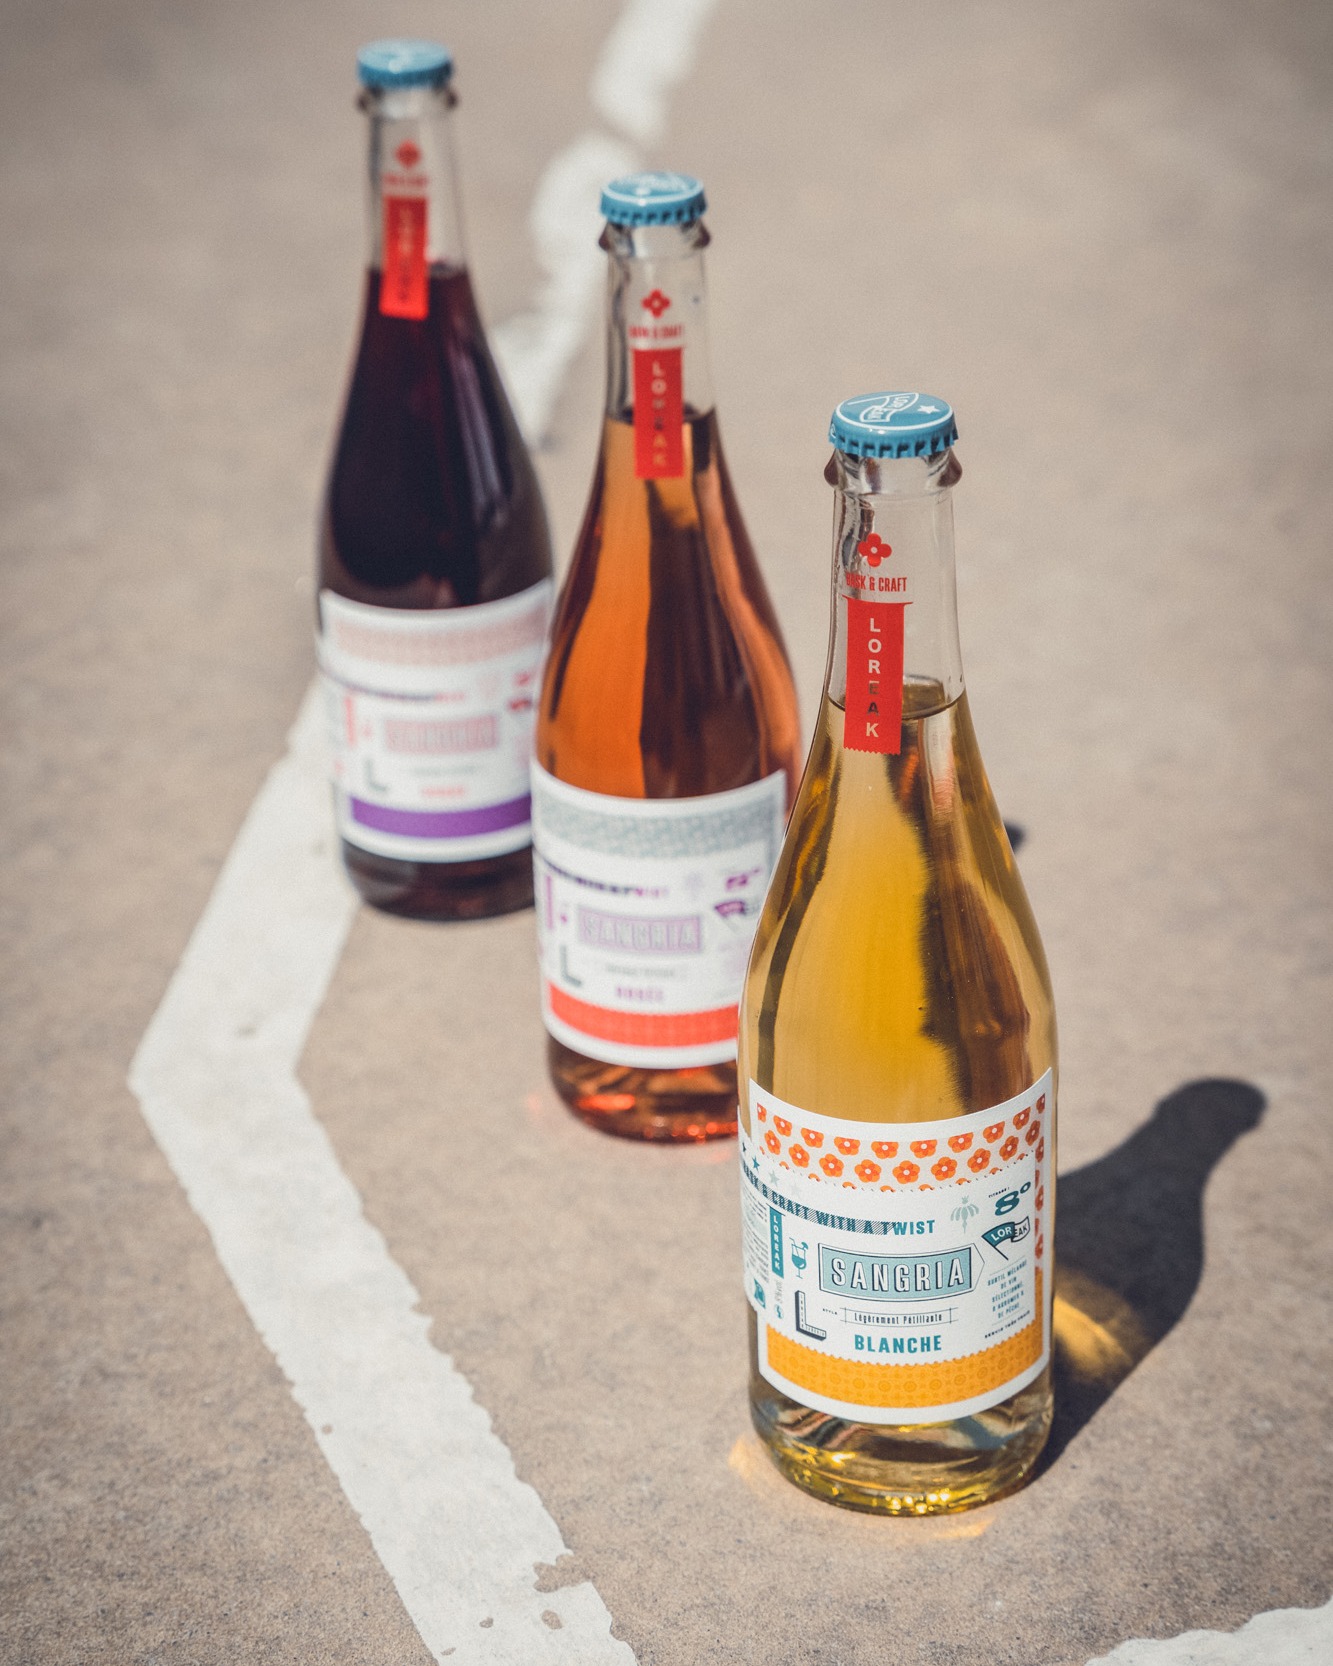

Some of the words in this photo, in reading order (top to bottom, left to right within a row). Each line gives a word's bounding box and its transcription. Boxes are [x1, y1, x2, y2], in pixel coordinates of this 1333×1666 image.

[846, 572, 867, 591] BASK
[868, 576, 875, 591] &
[878, 577, 907, 592] CRAFT
[866, 617, 882, 738] LOREAK
[771, 1189, 811, 1221] CRAFT
[815, 1209, 856, 1233] WITH
[863, 1220, 875, 1235] A
[880, 1219, 935, 1236] TWIST
[773, 1214, 782, 1271] LOREAK
[831, 1257, 965, 1293] SANGRIA
[854, 1334, 942, 1354] BLANCHE
